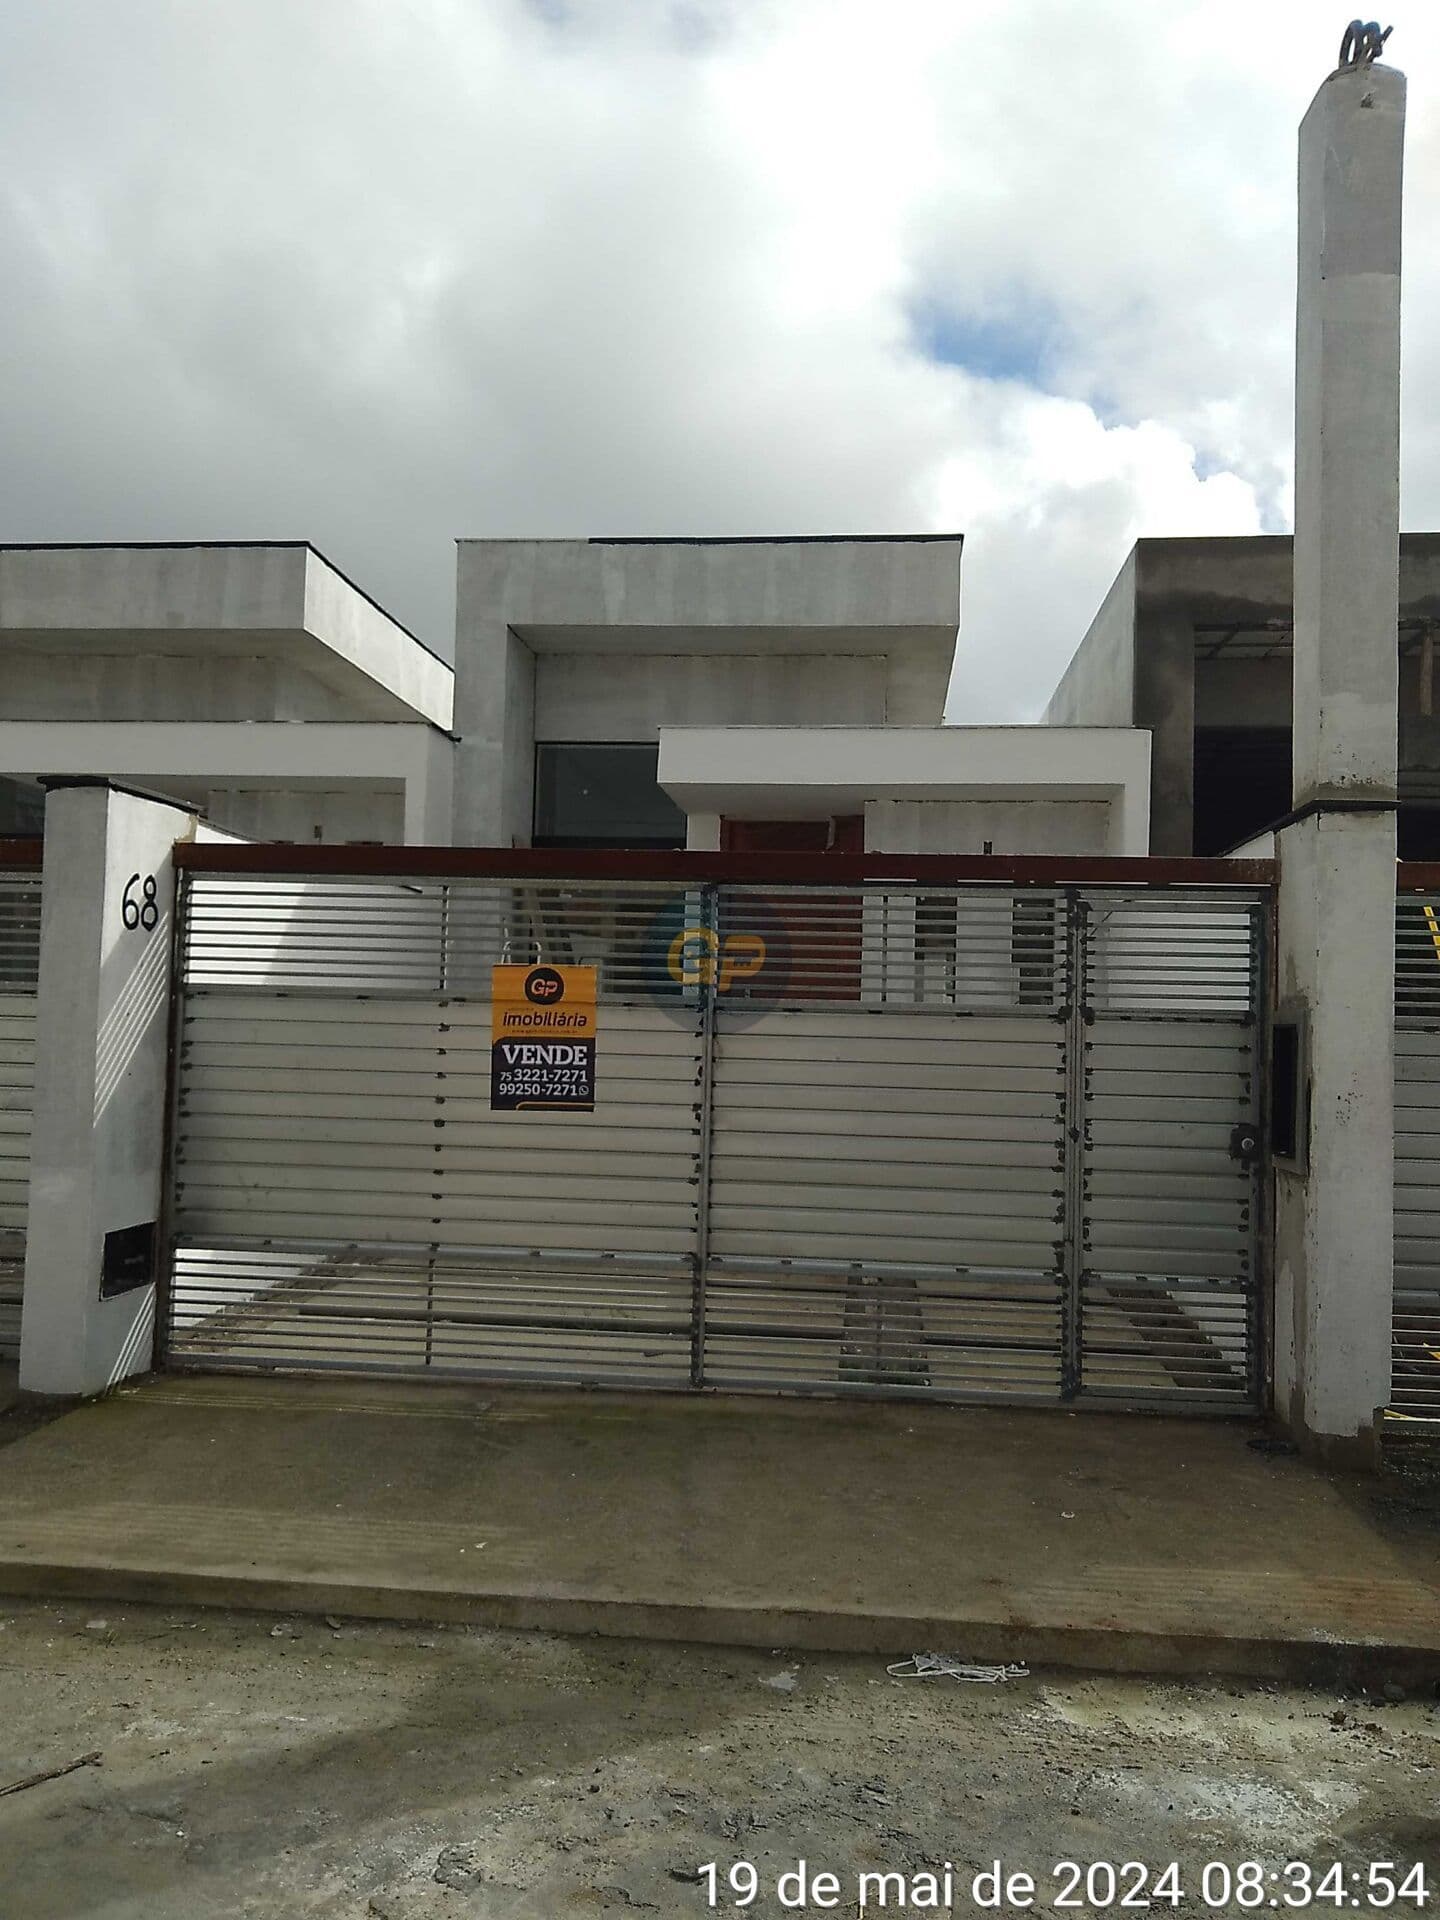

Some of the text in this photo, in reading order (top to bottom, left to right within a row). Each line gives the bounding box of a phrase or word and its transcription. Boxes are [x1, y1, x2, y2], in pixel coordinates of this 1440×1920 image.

[122, 873, 158, 932] 68
[531, 978, 559, 997] GP
[502, 1012, 588, 1027] imobiliária
[502, 1044, 588, 1066] VENDE
[500, 1068, 588, 1082] 75 3221-7271
[499, 1083, 577, 1096] 99250-7271
